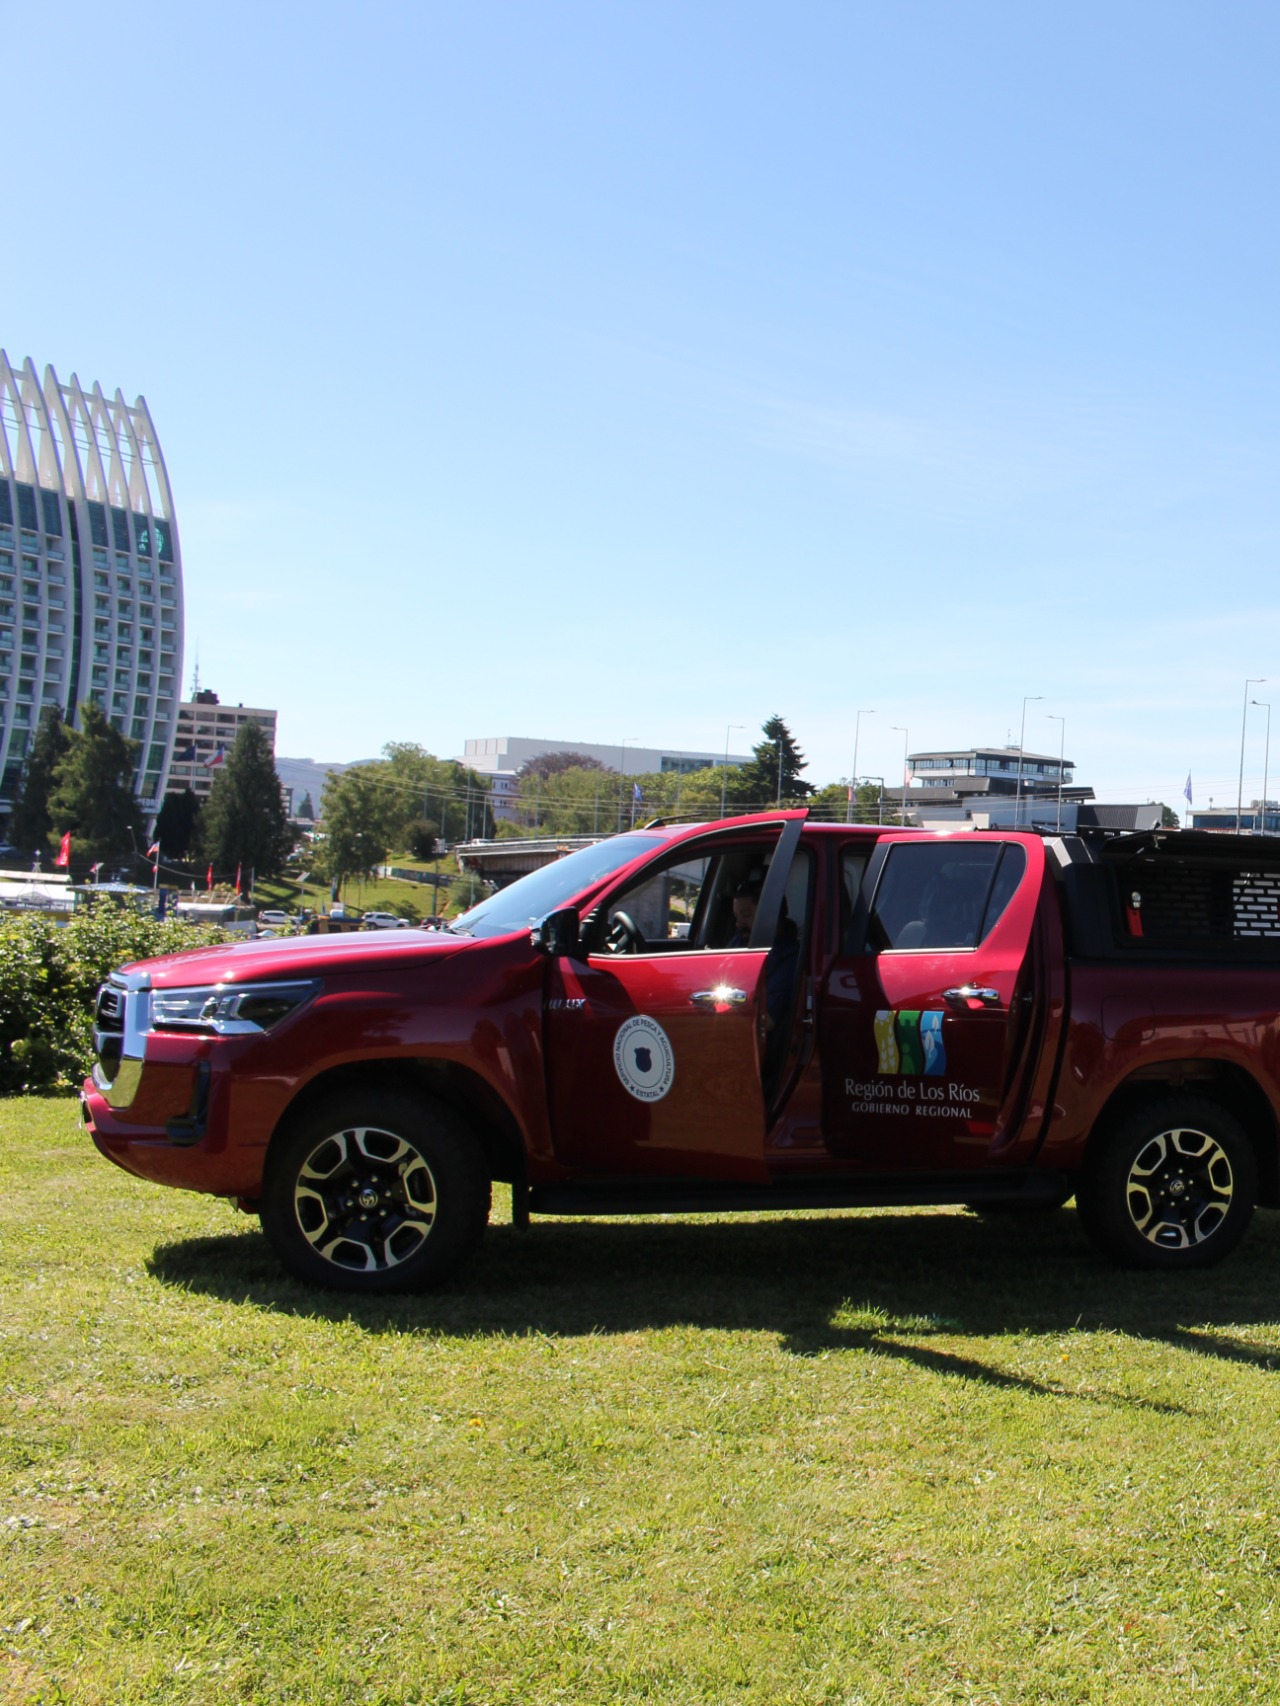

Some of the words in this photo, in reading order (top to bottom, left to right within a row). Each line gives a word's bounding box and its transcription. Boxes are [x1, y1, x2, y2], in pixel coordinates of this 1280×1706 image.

[616, 1023, 633, 1052] NACIONAL
[632, 1018, 640, 1027] DE
[640, 1018, 657, 1033] PESCA
[635, 1088, 660, 1099] ESTATAL
[845, 1078, 894, 1101] Región
[897, 1080, 916, 1099] de
[920, 1082, 945, 1101] Los
[948, 1083, 980, 1102] Ríos
[851, 1101, 910, 1116] GOBIERNO
[915, 1105, 973, 1119] REGIONAL
